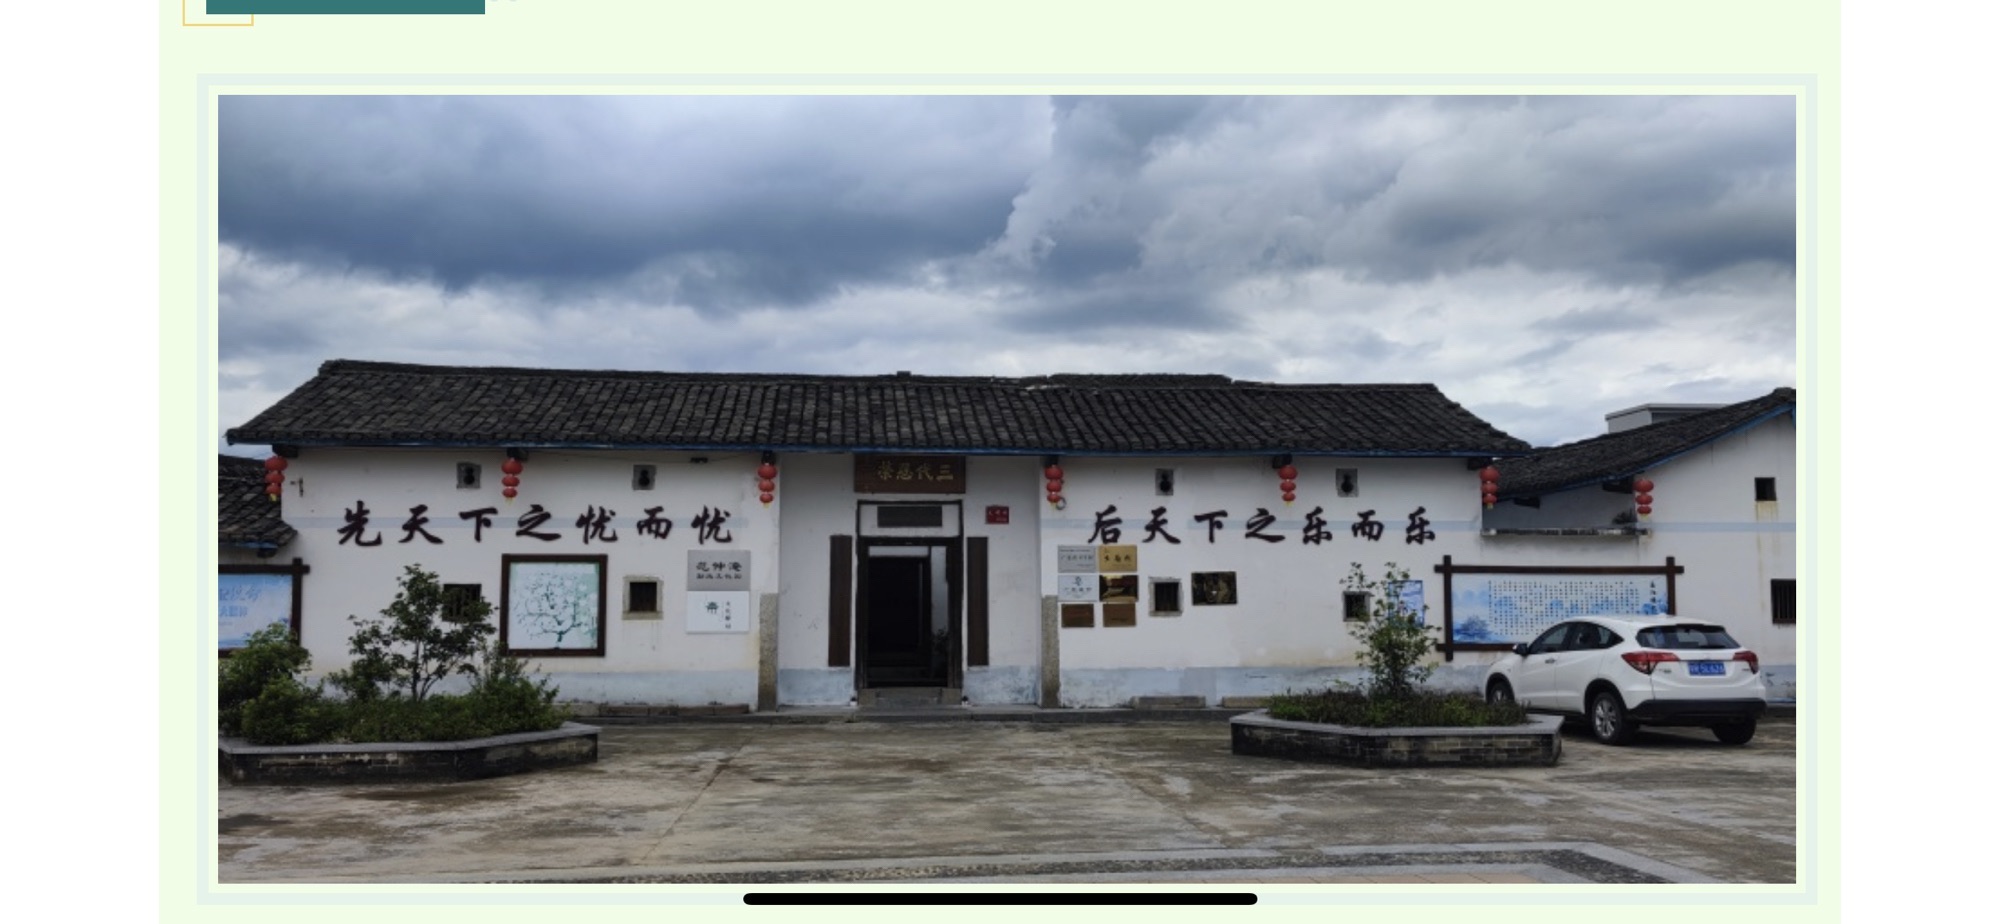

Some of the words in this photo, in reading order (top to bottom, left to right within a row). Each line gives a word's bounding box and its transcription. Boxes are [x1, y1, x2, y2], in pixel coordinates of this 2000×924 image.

[337, 500, 732, 547] 先天下之忧而忧
[1087, 505, 1436, 546] 后天下之乐而乐
